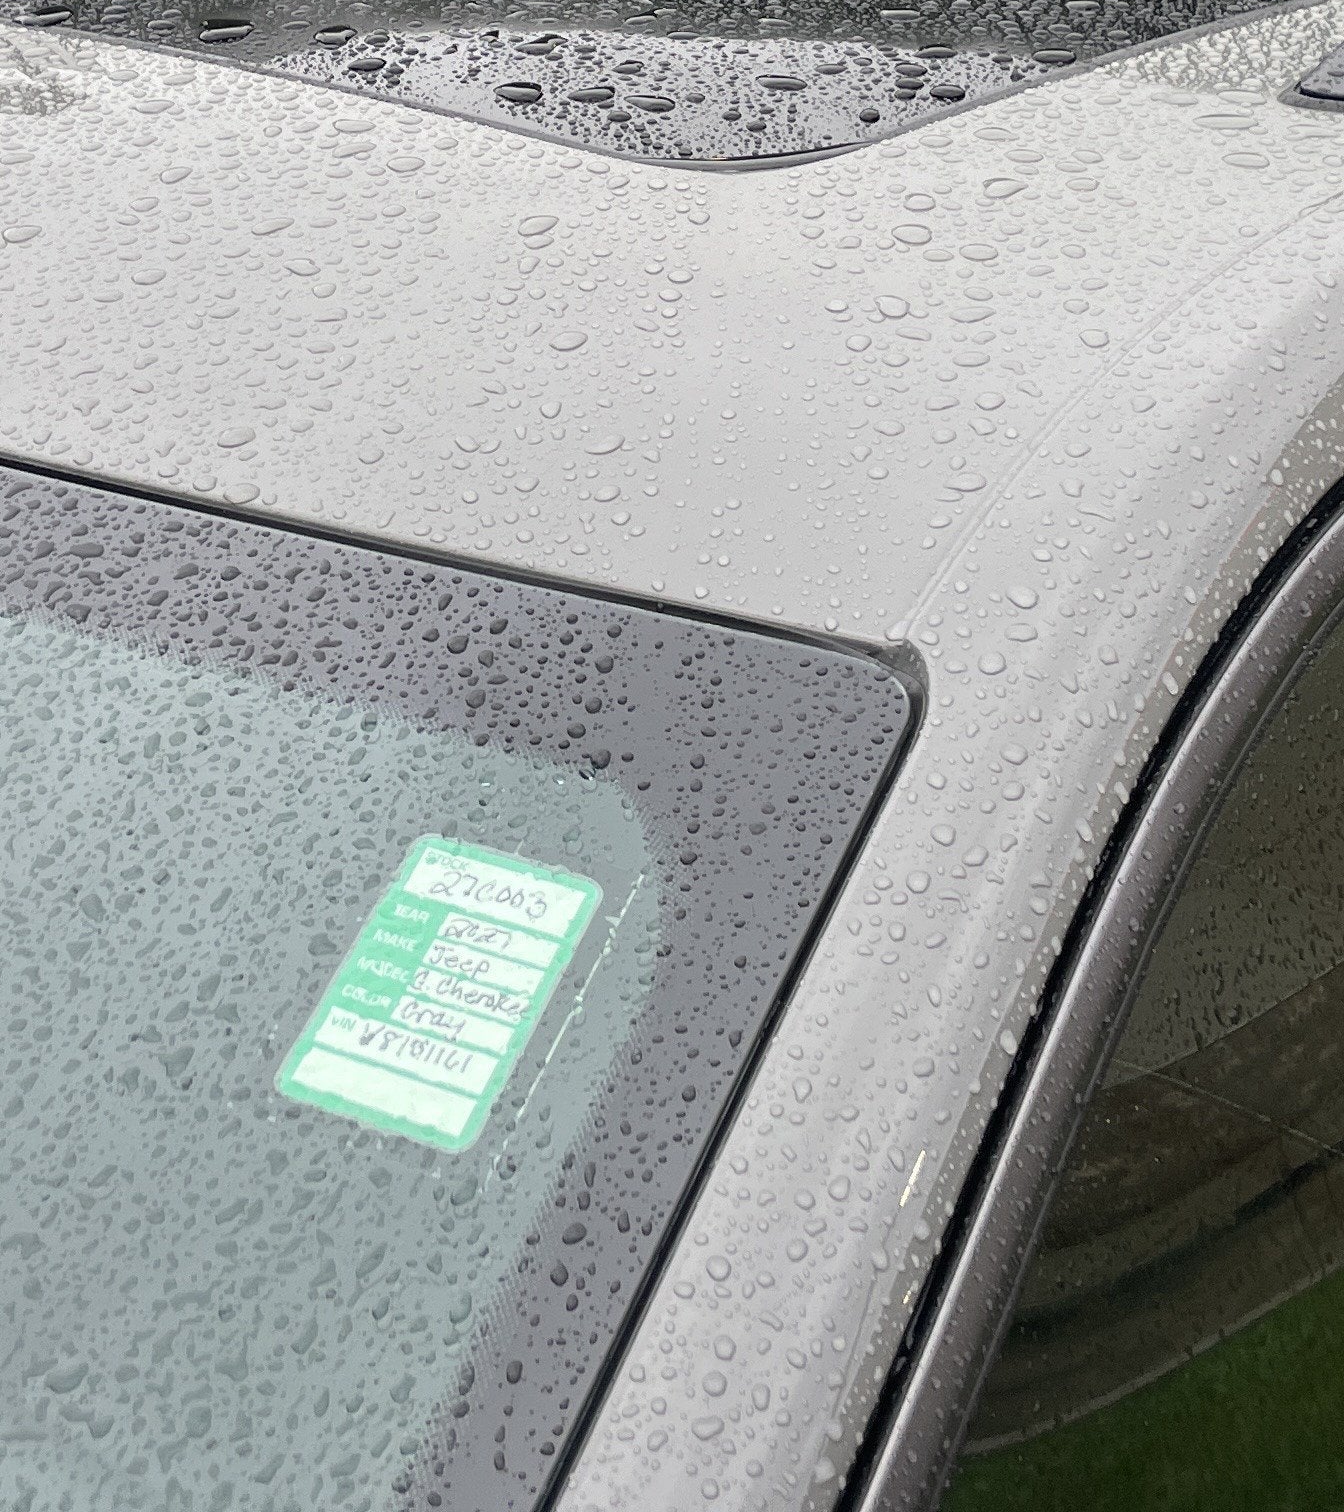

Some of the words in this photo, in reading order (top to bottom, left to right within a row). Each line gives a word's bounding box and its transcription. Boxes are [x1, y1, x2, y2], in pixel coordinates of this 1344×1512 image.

[393, 902, 431, 925] YEAR
[372, 928, 419, 953] MAKE
[429, 943, 490, 982] Jeep
[341, 984, 393, 1010] COLOR
[331, 1015, 357, 1032] VIN
